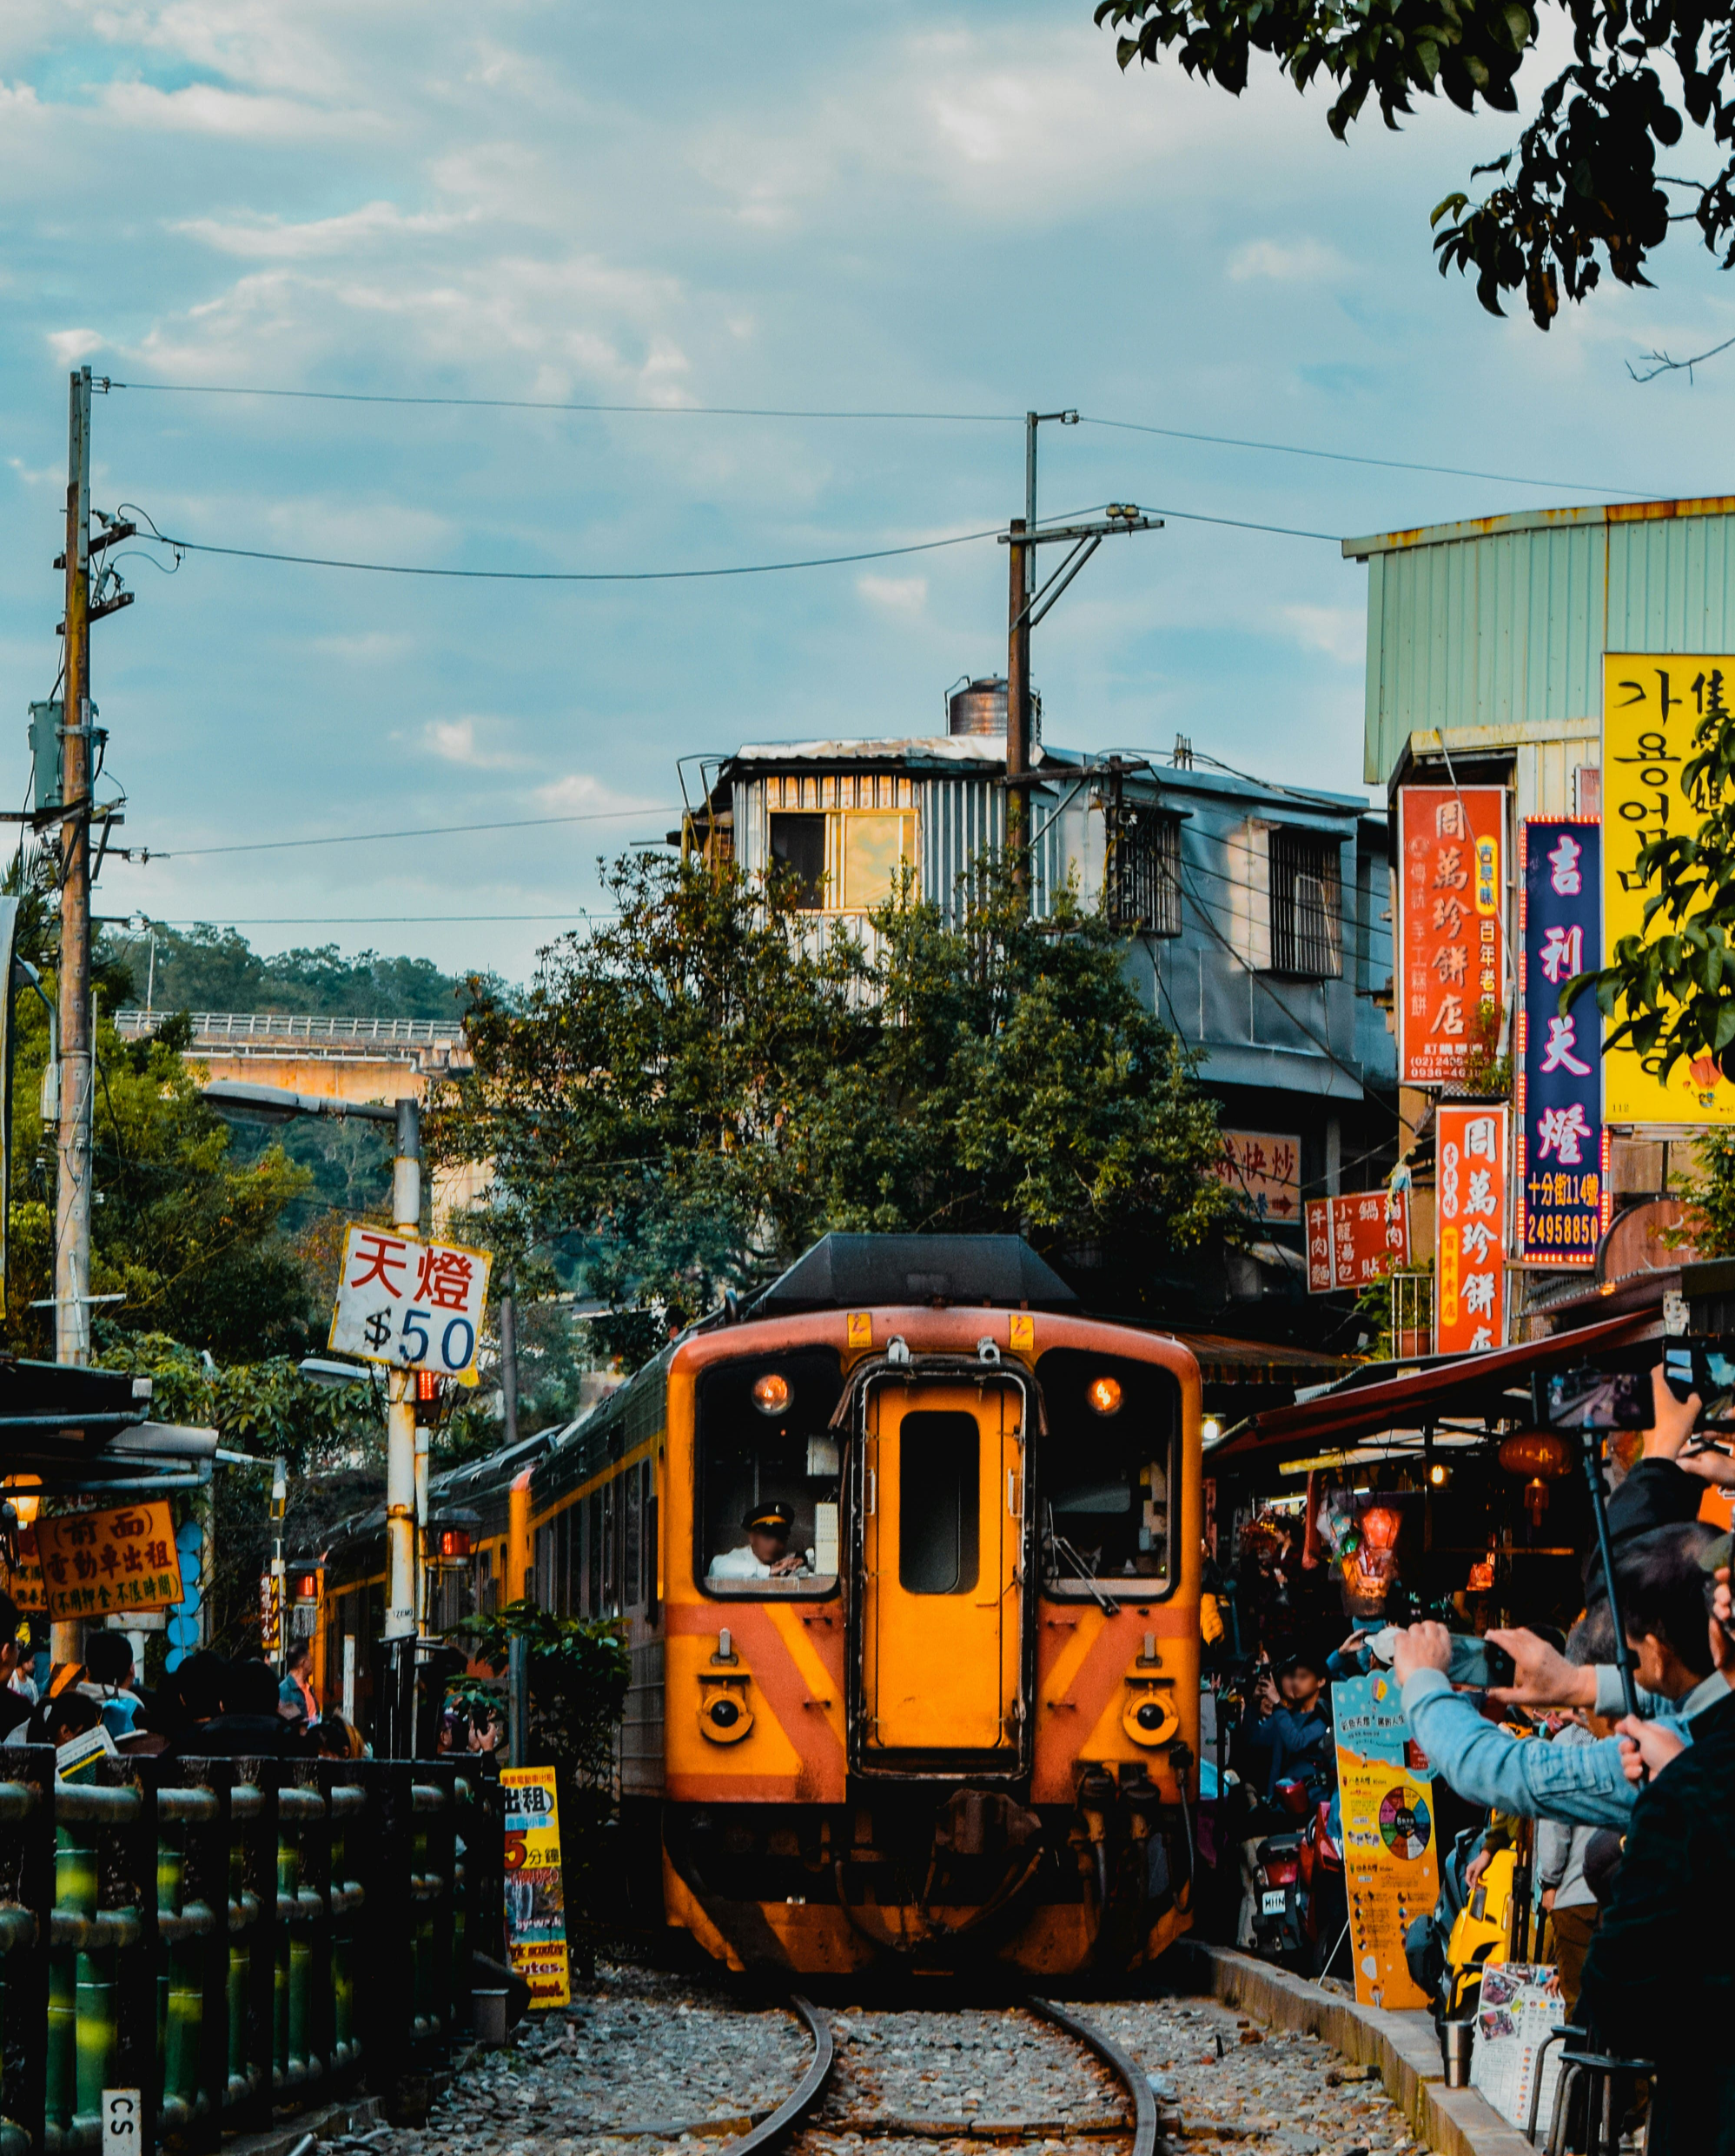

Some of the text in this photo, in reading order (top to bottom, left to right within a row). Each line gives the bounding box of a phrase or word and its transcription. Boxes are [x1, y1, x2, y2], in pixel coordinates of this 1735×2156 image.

[1431, 799, 1473, 1035] 周萬珍餅店
[1537, 833, 1593, 1164] 吉利天燈
[1444, 1144, 1457, 1217] 古早味
[1527, 1171, 1599, 1209] 十分街114號
[1309, 1206, 1330, 1286] 牛肉麵
[1527, 1213, 1599, 1245] 24958850
[350, 1233, 474, 1313] 天燈
[363, 1305, 475, 1371] $50
[46, 1539, 173, 1586] 電動車出租
